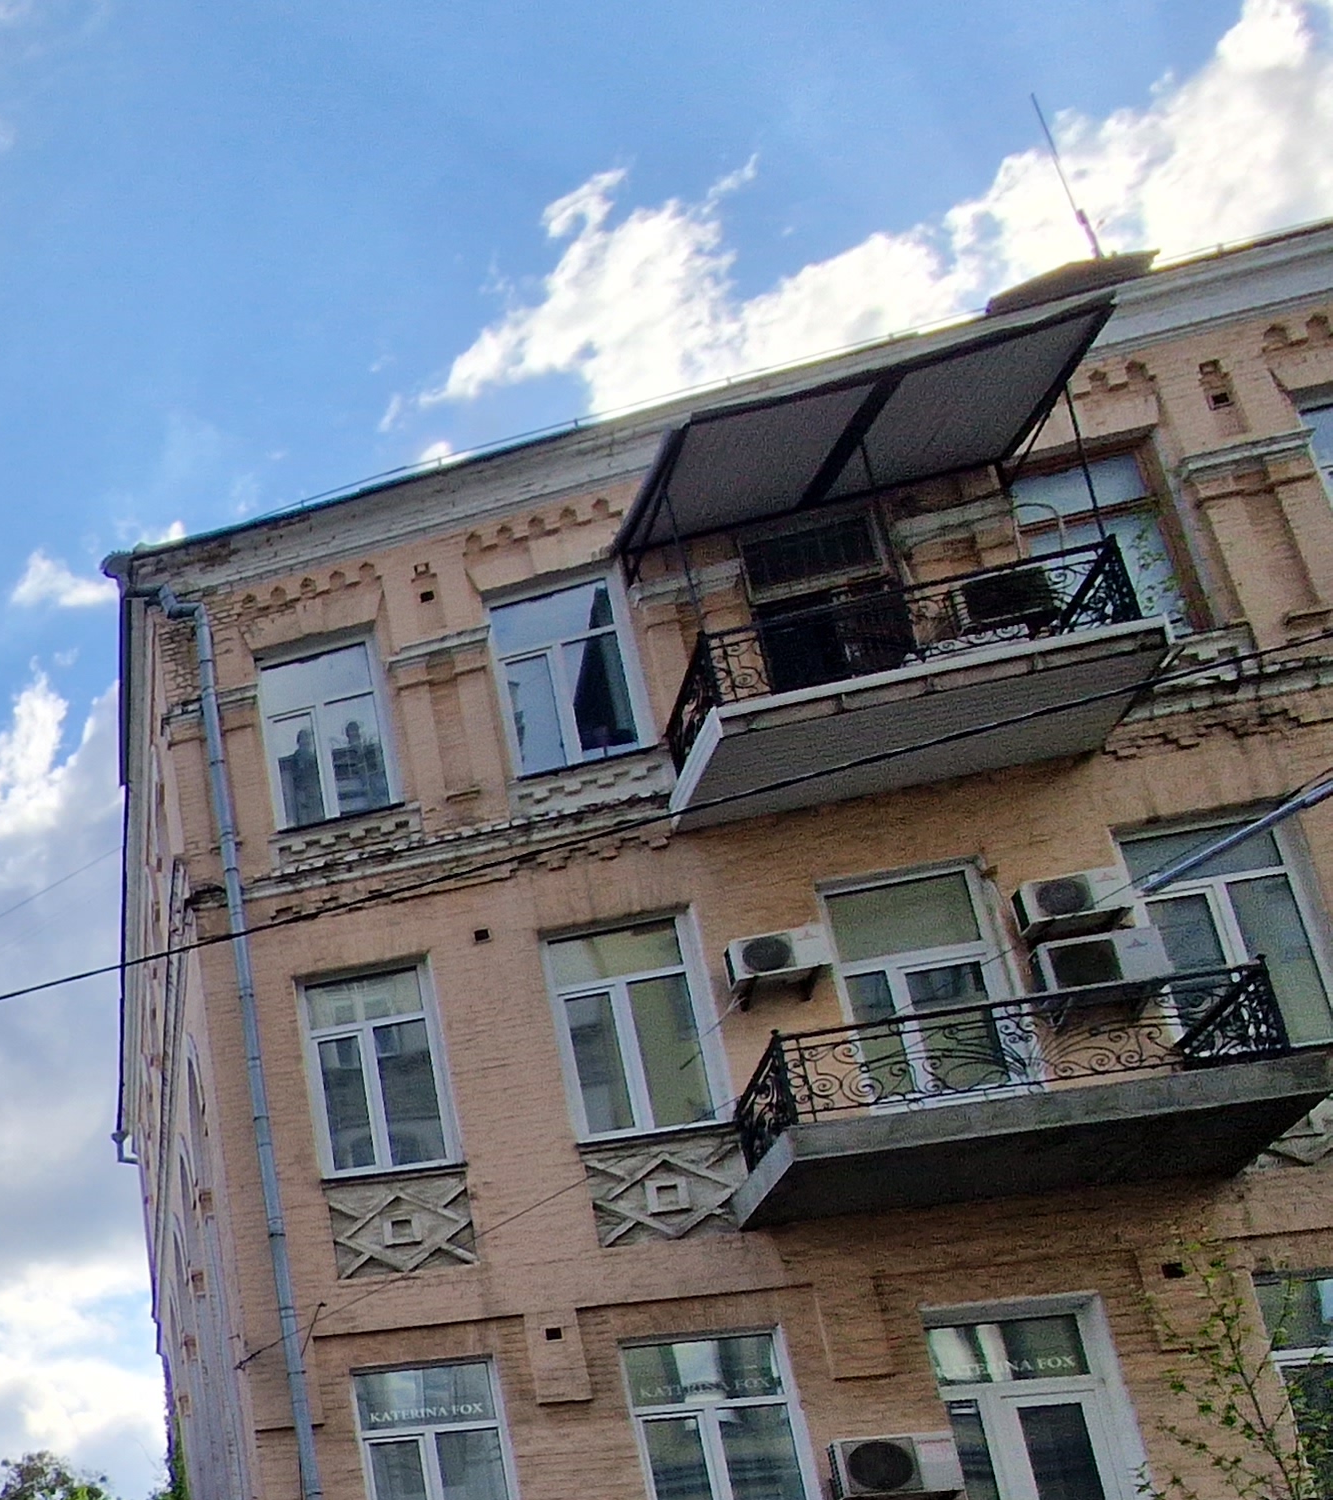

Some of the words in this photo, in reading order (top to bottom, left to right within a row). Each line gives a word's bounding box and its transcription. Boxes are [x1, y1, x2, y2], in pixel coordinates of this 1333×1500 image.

[1037, 1355, 1076, 1370] FOX
[370, 1406, 448, 1423] KATERINA
[452, 1402, 484, 1415] FOX
